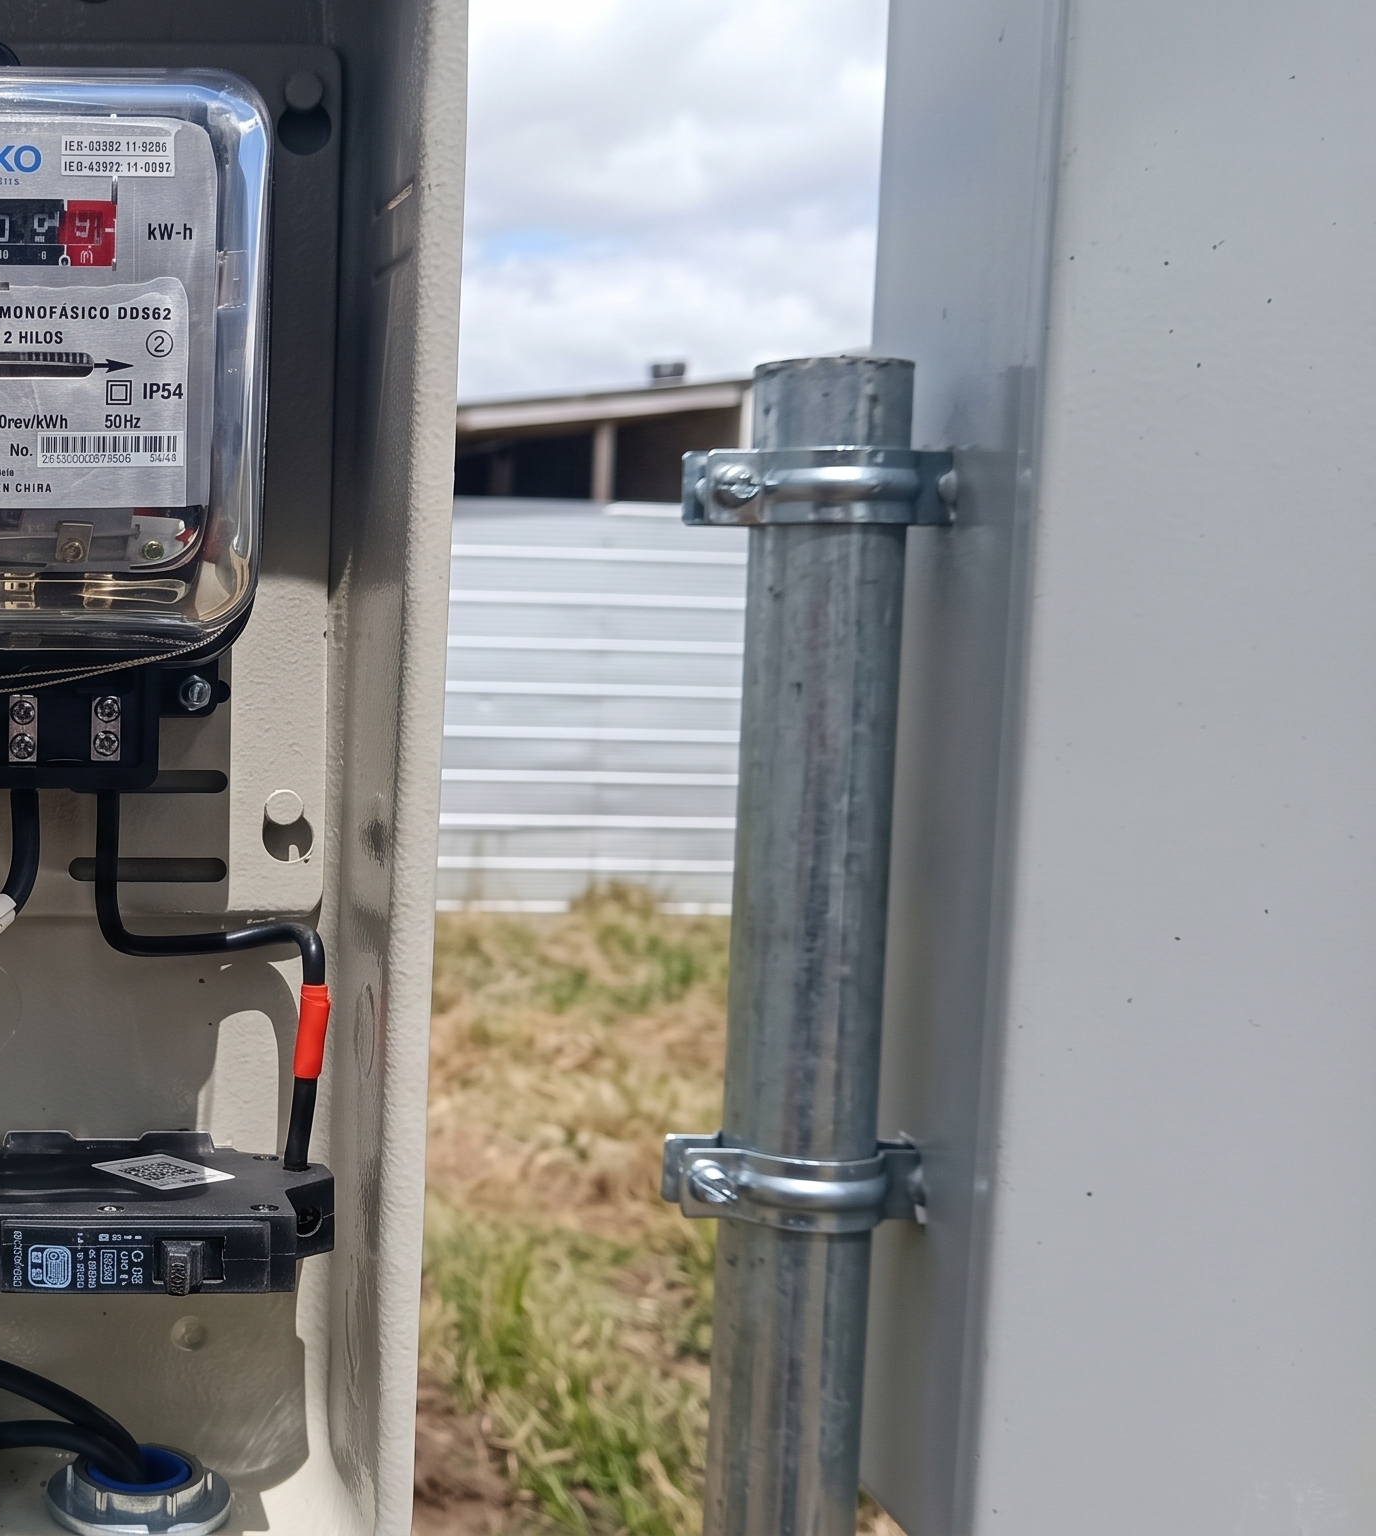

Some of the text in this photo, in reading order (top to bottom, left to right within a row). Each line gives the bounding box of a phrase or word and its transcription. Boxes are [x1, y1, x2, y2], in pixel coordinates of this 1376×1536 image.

[0, 303, 110, 320] MONOFÁSICO
[117, 306, 172, 321] DDS62
[3, 331, 64, 345] 2 HILOS
[142, 383, 184, 400] IP54
[10, 443, 33, 457] No.
